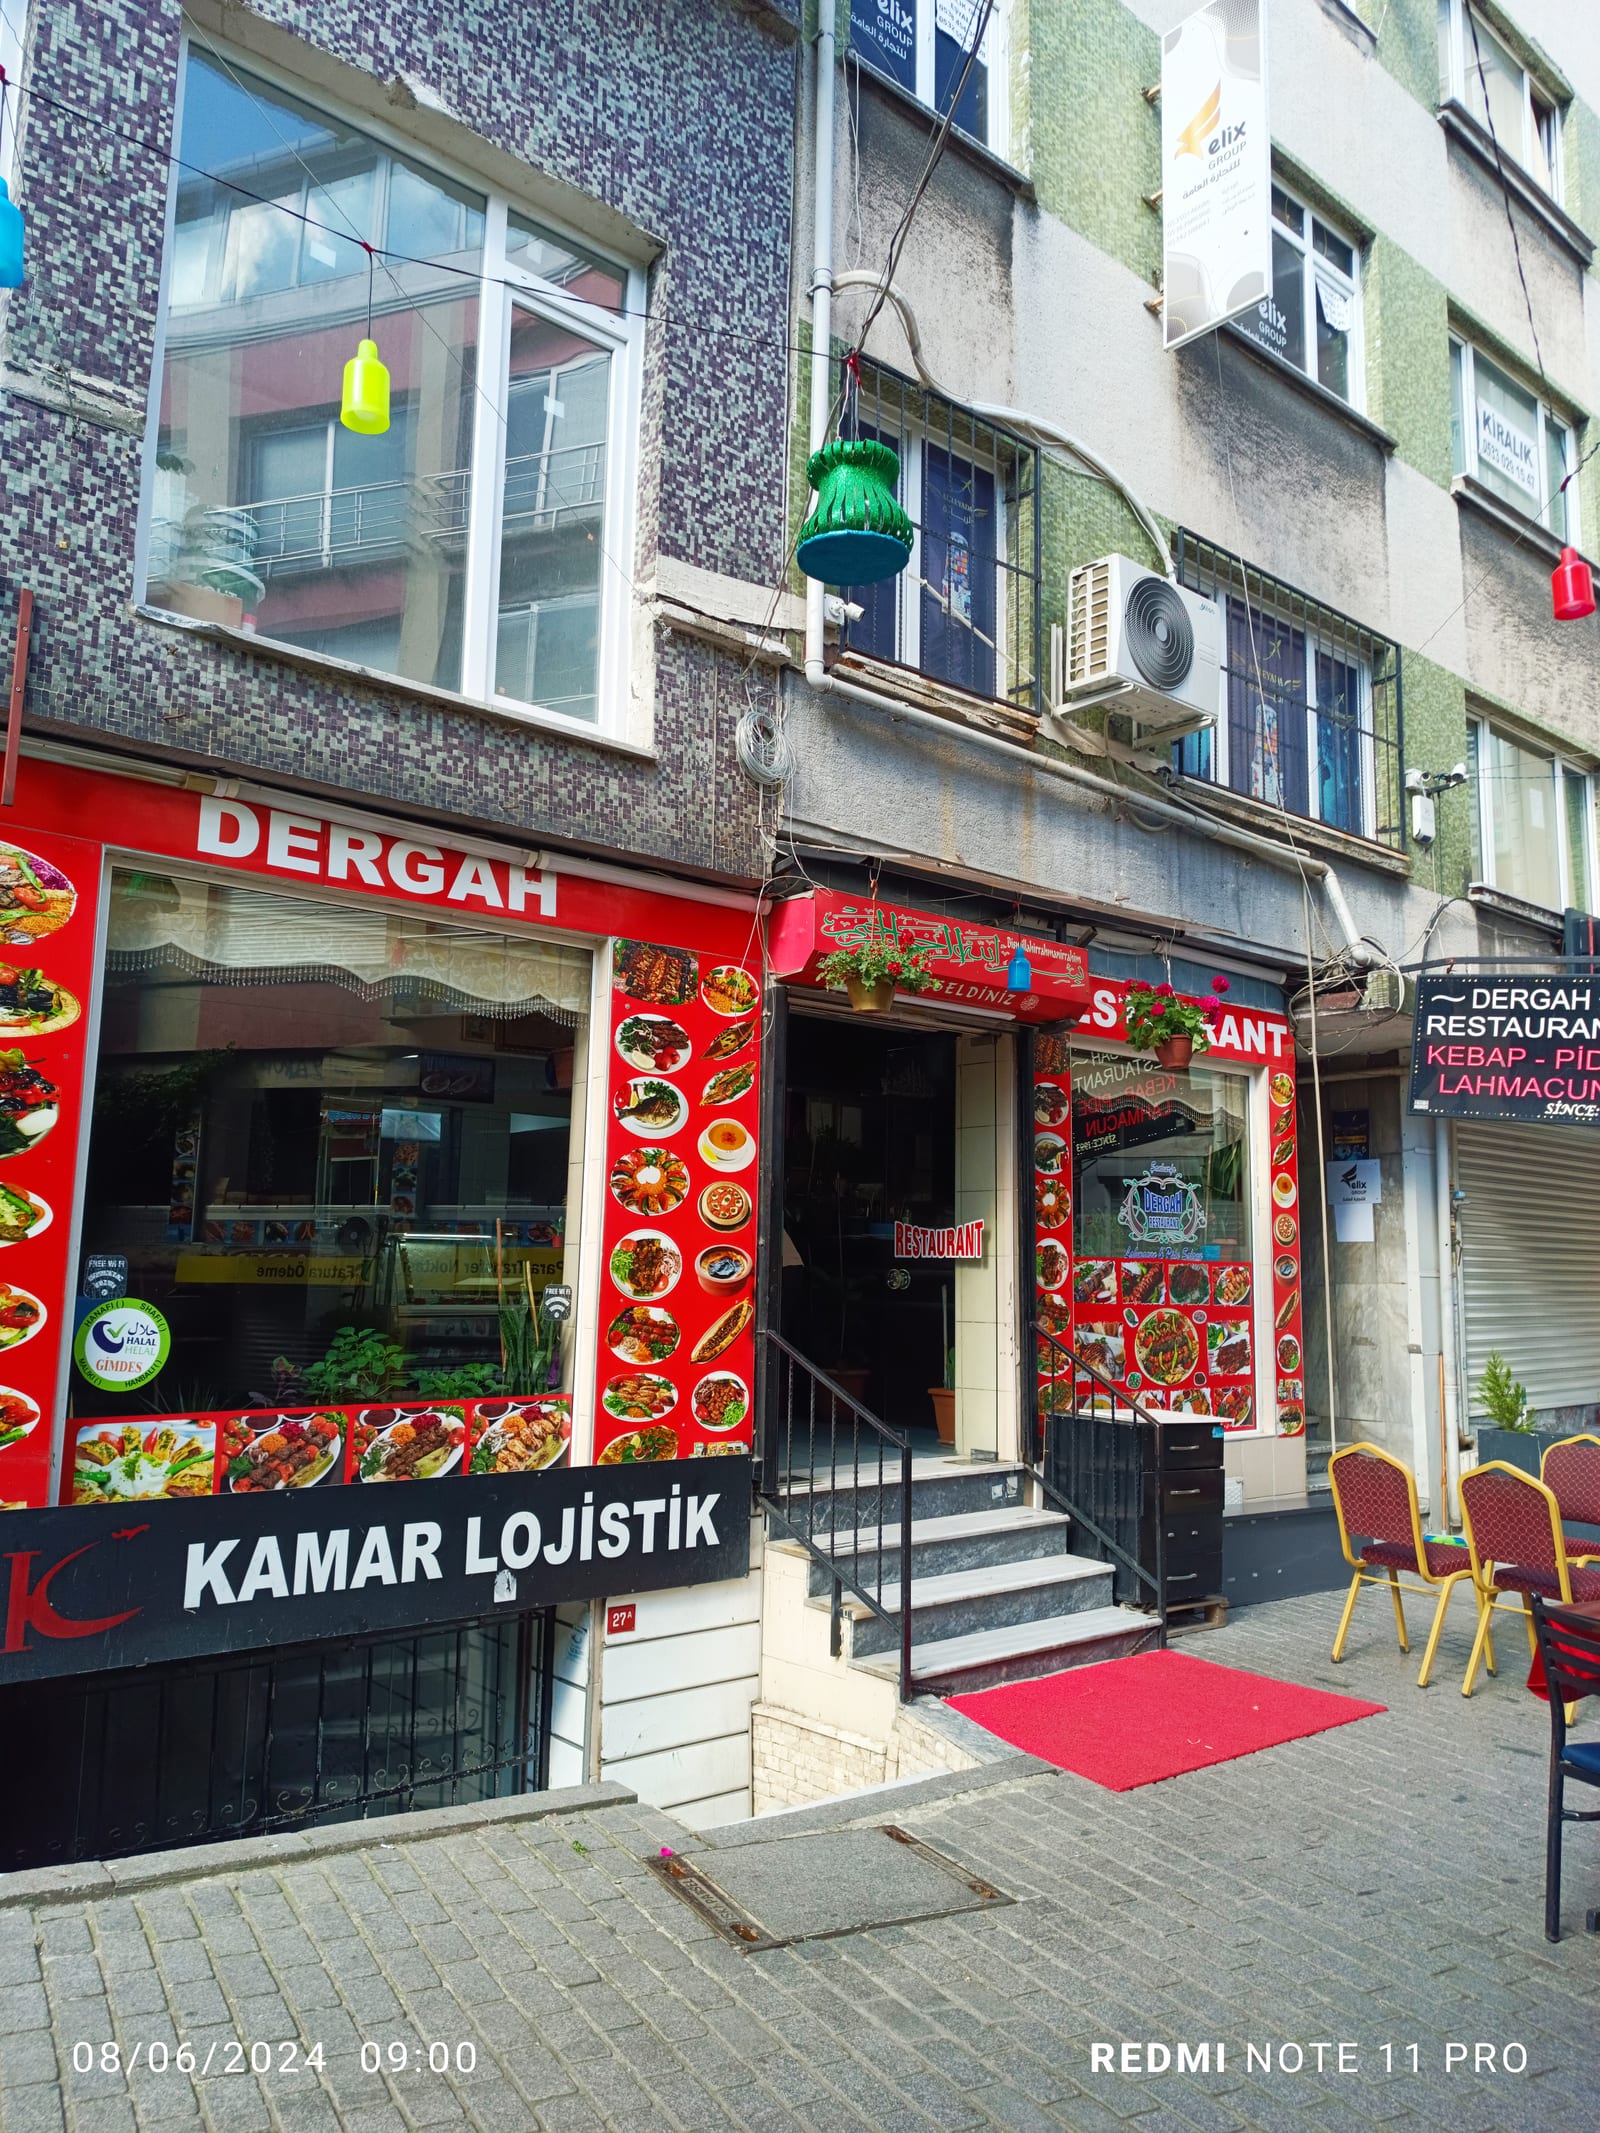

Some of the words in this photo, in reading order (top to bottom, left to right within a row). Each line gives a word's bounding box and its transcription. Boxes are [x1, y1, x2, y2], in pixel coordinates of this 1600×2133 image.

[877, 15, 913, 47] GROUP
[1208, 141, 1247, 170] GROUP
[1258, 321, 1287, 347] GROUP
[1482, 410, 1533, 468] KİRALIK
[196, 795, 557, 917] DERGAH
[1472, 988, 1591, 1011] DERGAH
[1427, 1045, 1527, 1068] KEBAP
[1144, 1187, 1183, 1213] DERGAH
[1148, 1216, 1180, 1229] RESTAURANT
[894, 1219, 984, 1258] RESTAURANT
[84, 1303, 114, 1328] HANAFI
[126, 1336, 157, 1346] HALAL
[128, 1321, 159, 1336] حلال
[124, 1346, 156, 1356] HELAL
[96, 1357, 143, 1373] GİMDES
[183, 1521, 443, 1609] KAMAR
[465, 1483, 721, 1576] LOJİSTİK
